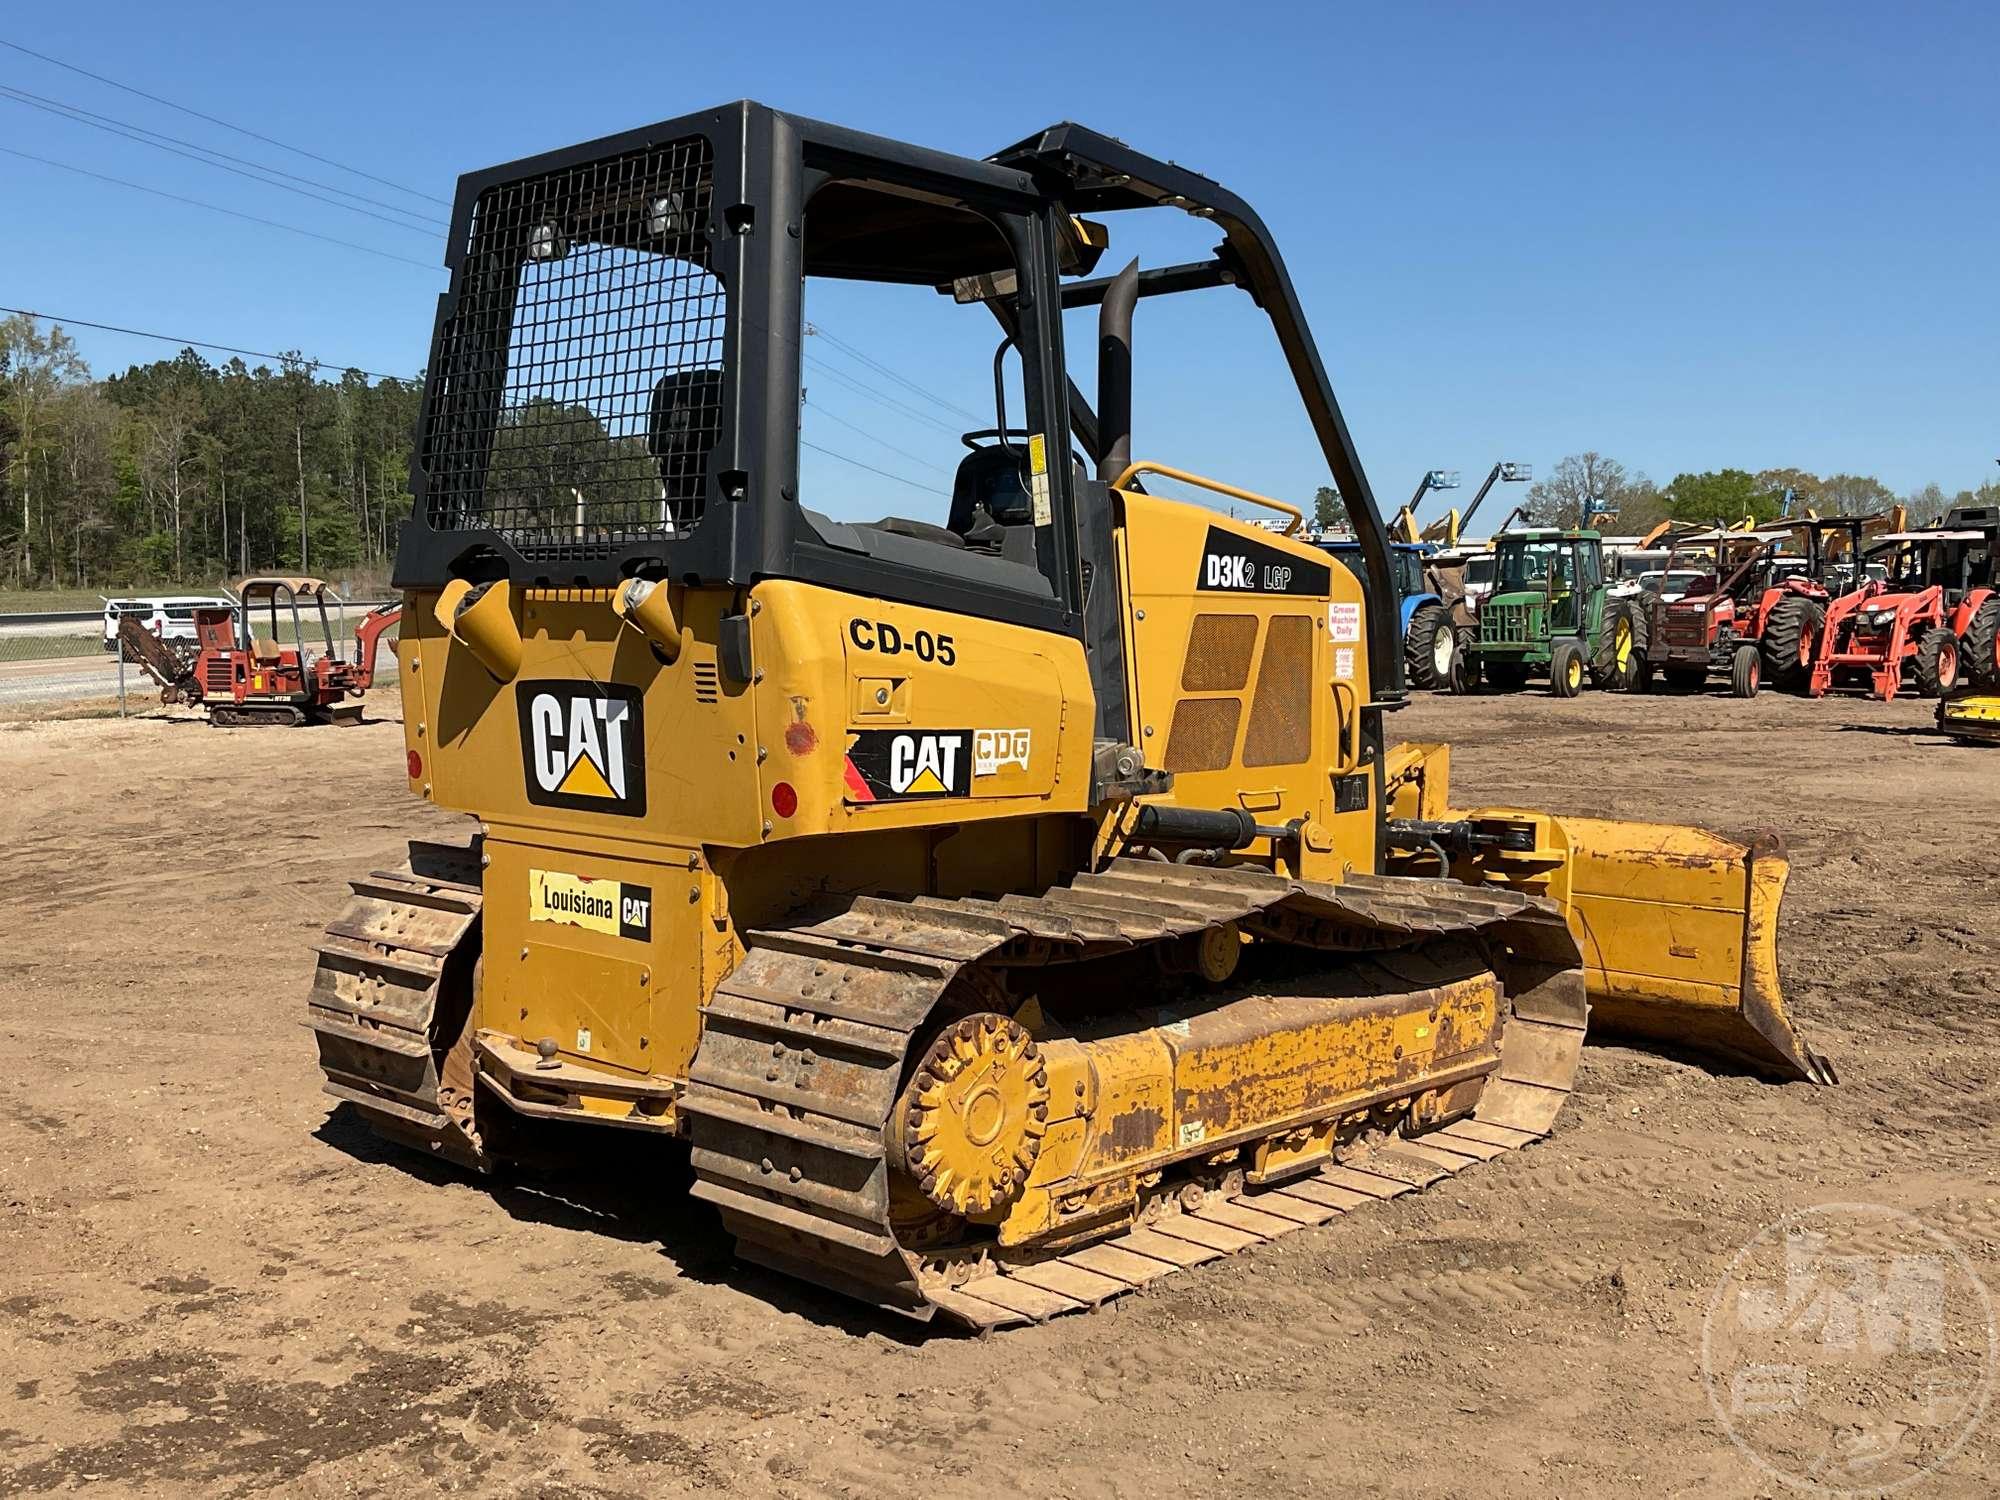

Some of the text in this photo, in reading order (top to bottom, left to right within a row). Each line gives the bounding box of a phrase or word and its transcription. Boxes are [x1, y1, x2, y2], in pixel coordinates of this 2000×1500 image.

[1264, 565, 1291, 590] LGP
[1332, 616, 1358, 625] Machine
[1334, 606, 1356, 614] Grease
[849, 618, 956, 666] CD-05
[1336, 626, 1353, 636] Daily
[531, 693, 629, 800] CAT
[976, 732, 1029, 760] CDG
[891, 735, 962, 793] CAT
[544, 885, 613, 919] Louisiana
[623, 896, 649, 928] CAT
